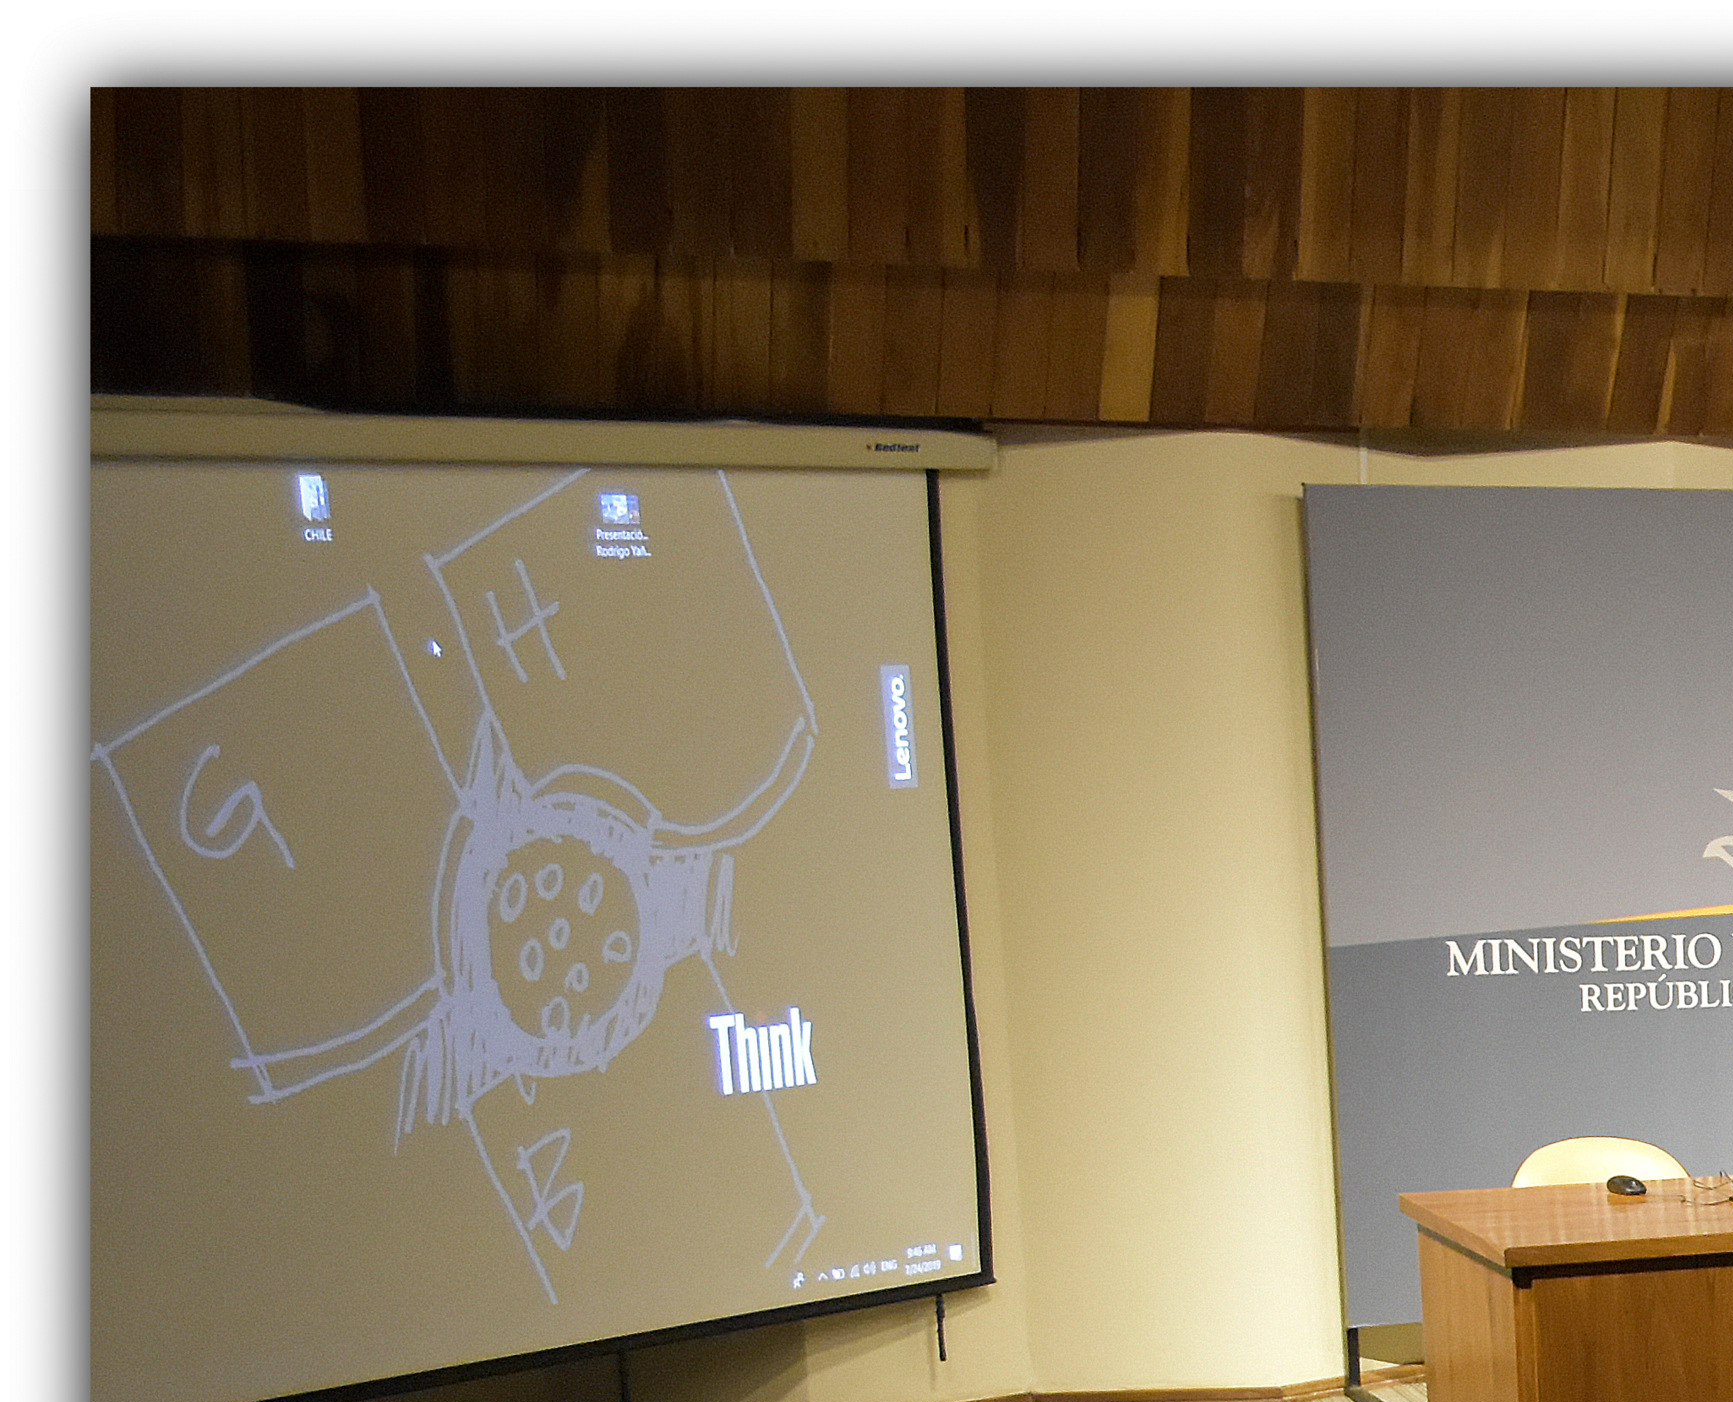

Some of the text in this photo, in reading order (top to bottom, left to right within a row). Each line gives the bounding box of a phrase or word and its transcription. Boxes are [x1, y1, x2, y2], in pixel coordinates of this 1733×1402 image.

[304, 529, 333, 541] CHILE
[596, 545, 630, 559] Rodrigo
[891, 674, 912, 781] Lenovo
[1446, 930, 1722, 977] MINISTERIO
[708, 1006, 818, 1095] Think
[880, 1259, 898, 1272] ENG
